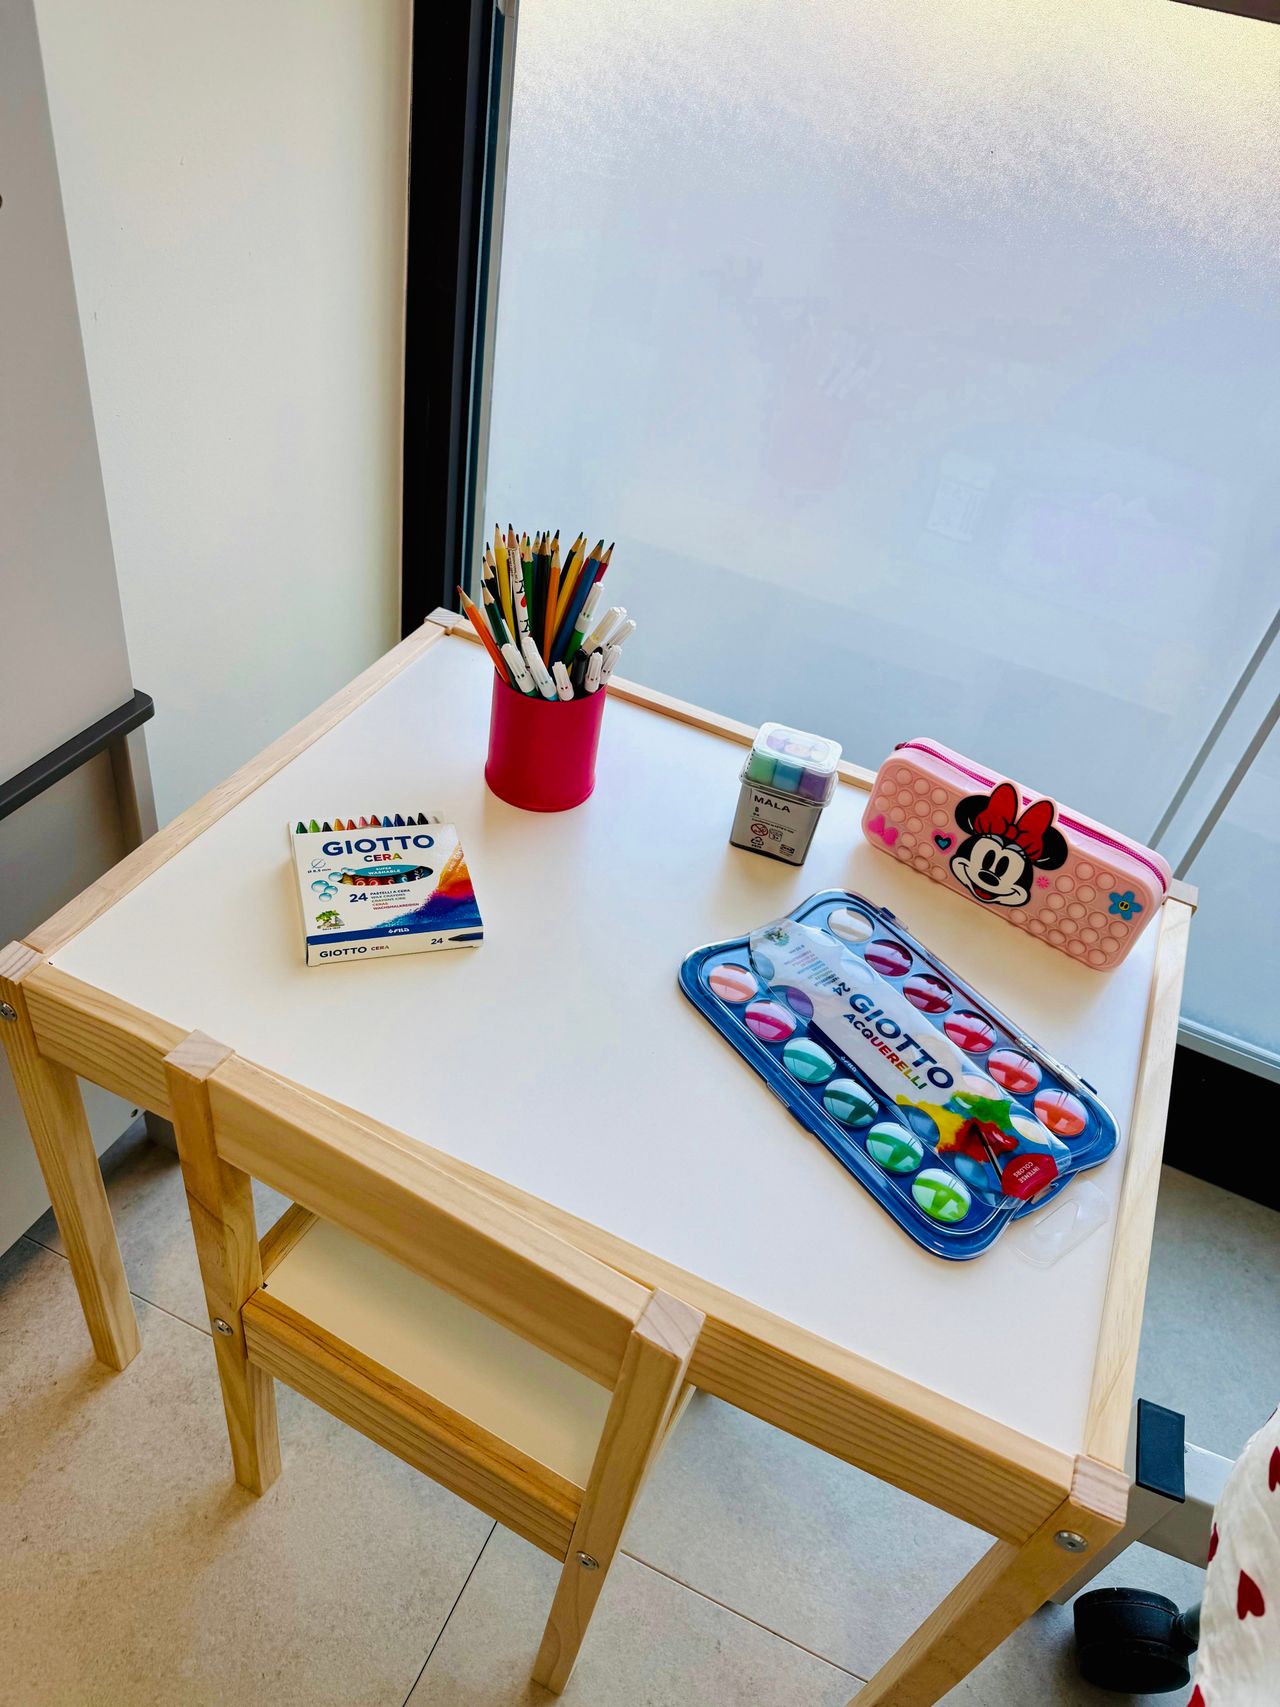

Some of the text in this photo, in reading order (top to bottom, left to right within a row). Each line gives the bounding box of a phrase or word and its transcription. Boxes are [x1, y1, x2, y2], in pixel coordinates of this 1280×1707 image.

[322, 834, 435, 857] GIOTTO
[363, 853, 403, 863] CERA
[349, 892, 368, 903] 24
[430, 937, 444, 945] 24
[319, 946, 367, 958] GIOTTO
[832, 981, 851, 996] 24
[849, 993, 954, 1089] GIOTTO
[843, 1013, 928, 1090] ACQUERELLI
[1013, 1161, 1034, 1177] COLORS
[1018, 1166, 1040, 1184] INTENSE
